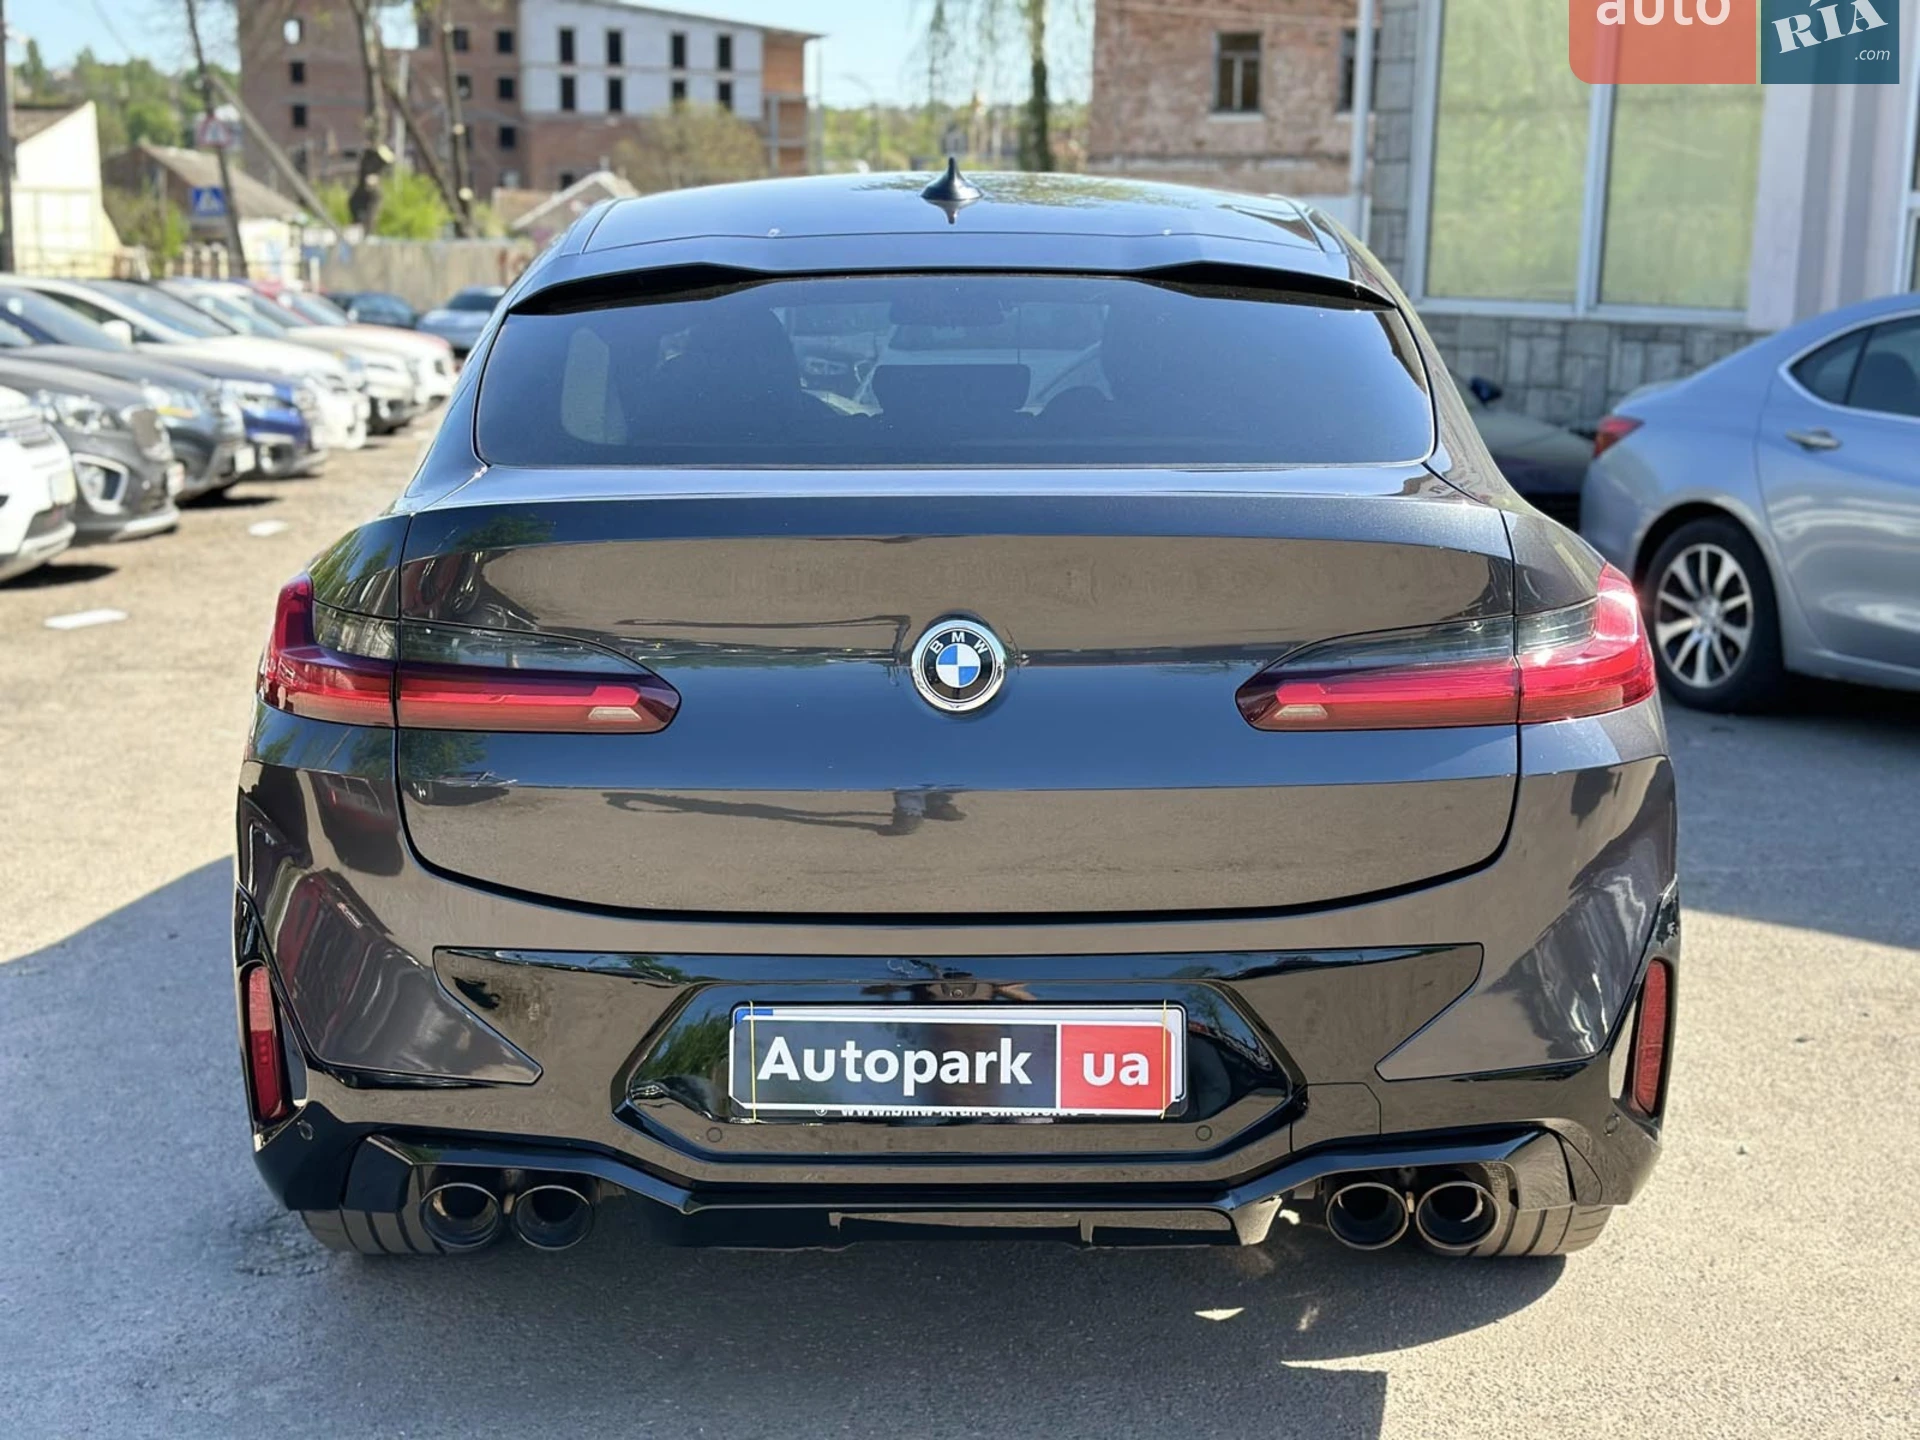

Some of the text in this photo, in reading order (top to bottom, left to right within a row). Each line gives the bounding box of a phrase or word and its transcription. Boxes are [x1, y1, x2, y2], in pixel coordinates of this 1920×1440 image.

[929, 631, 989, 655] BMW
[756, 1036, 1150, 1097] Autopark ua
